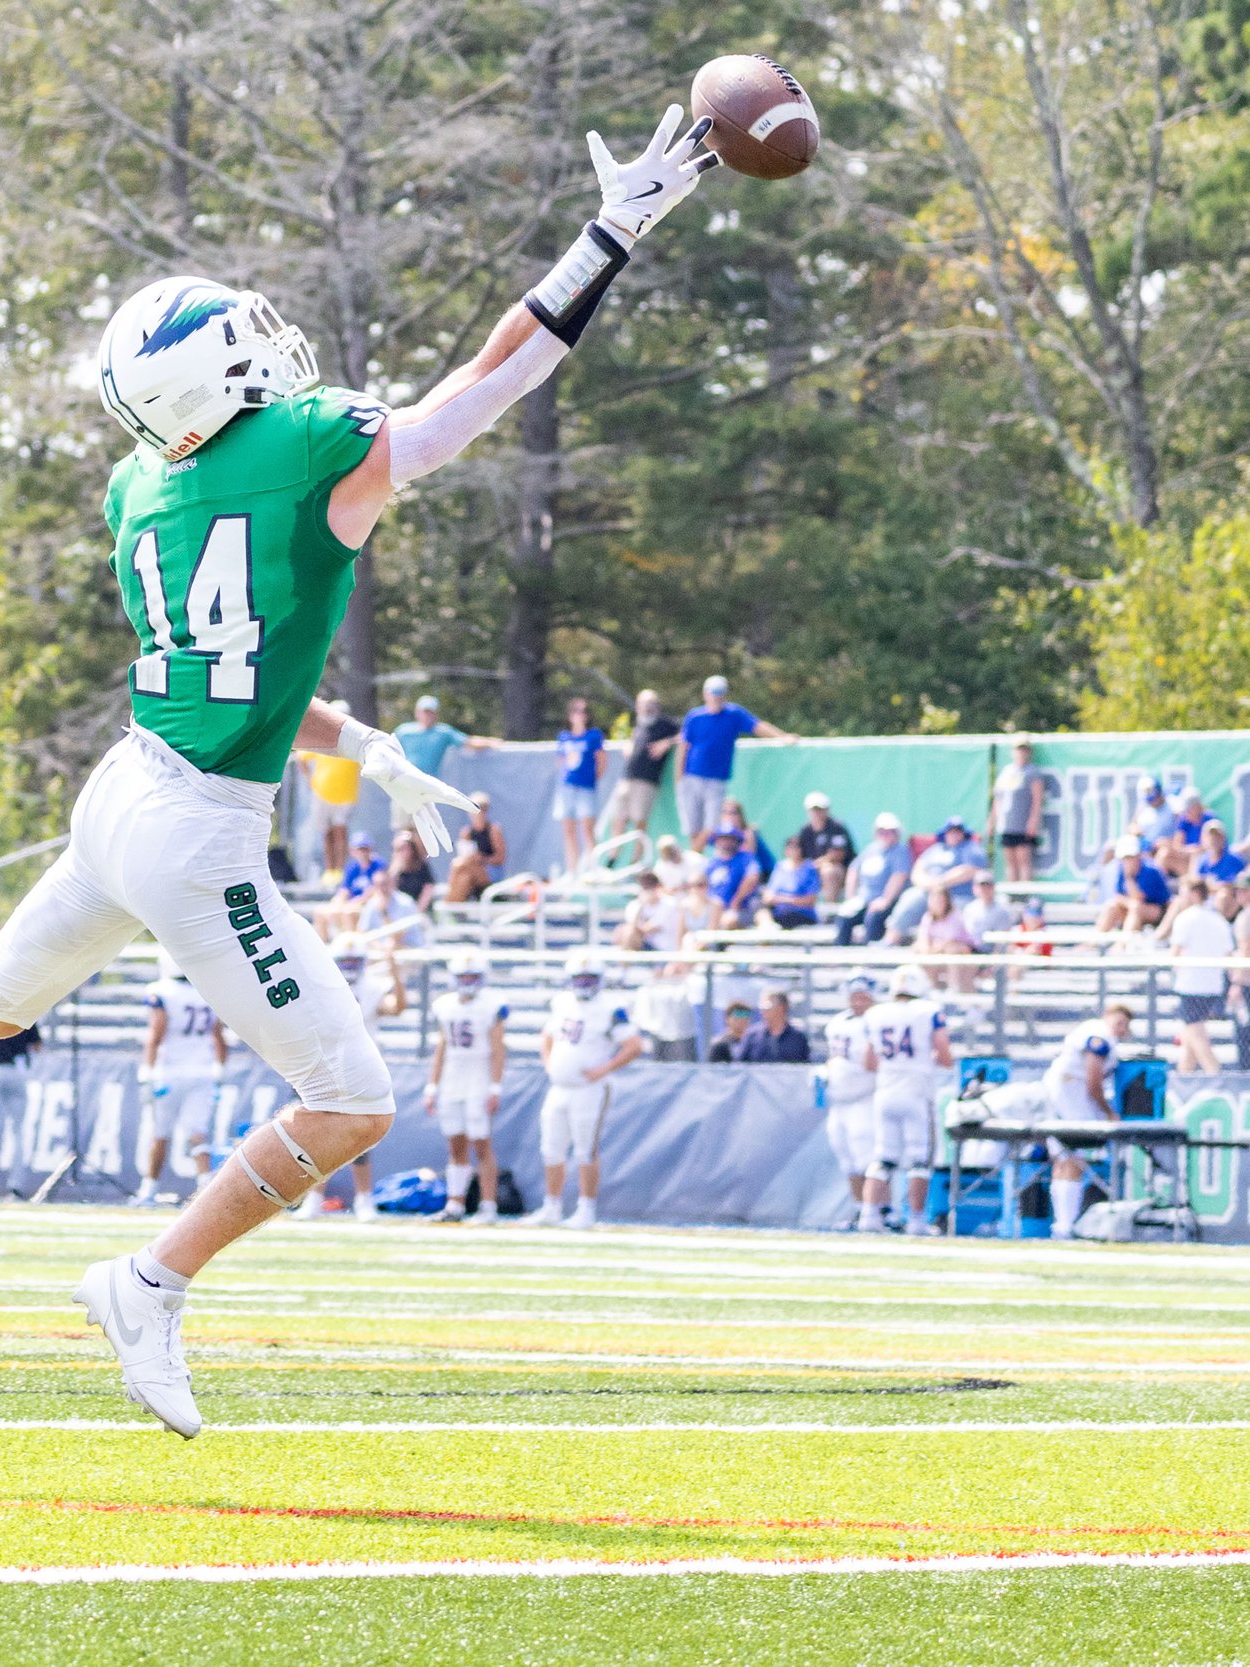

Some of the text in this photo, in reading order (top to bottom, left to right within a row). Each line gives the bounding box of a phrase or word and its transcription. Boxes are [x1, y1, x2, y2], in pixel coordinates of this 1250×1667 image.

[130, 512, 265, 705] 14
[224, 882, 300, 1010] GULLS
[880, 1025, 914, 1059] 54
